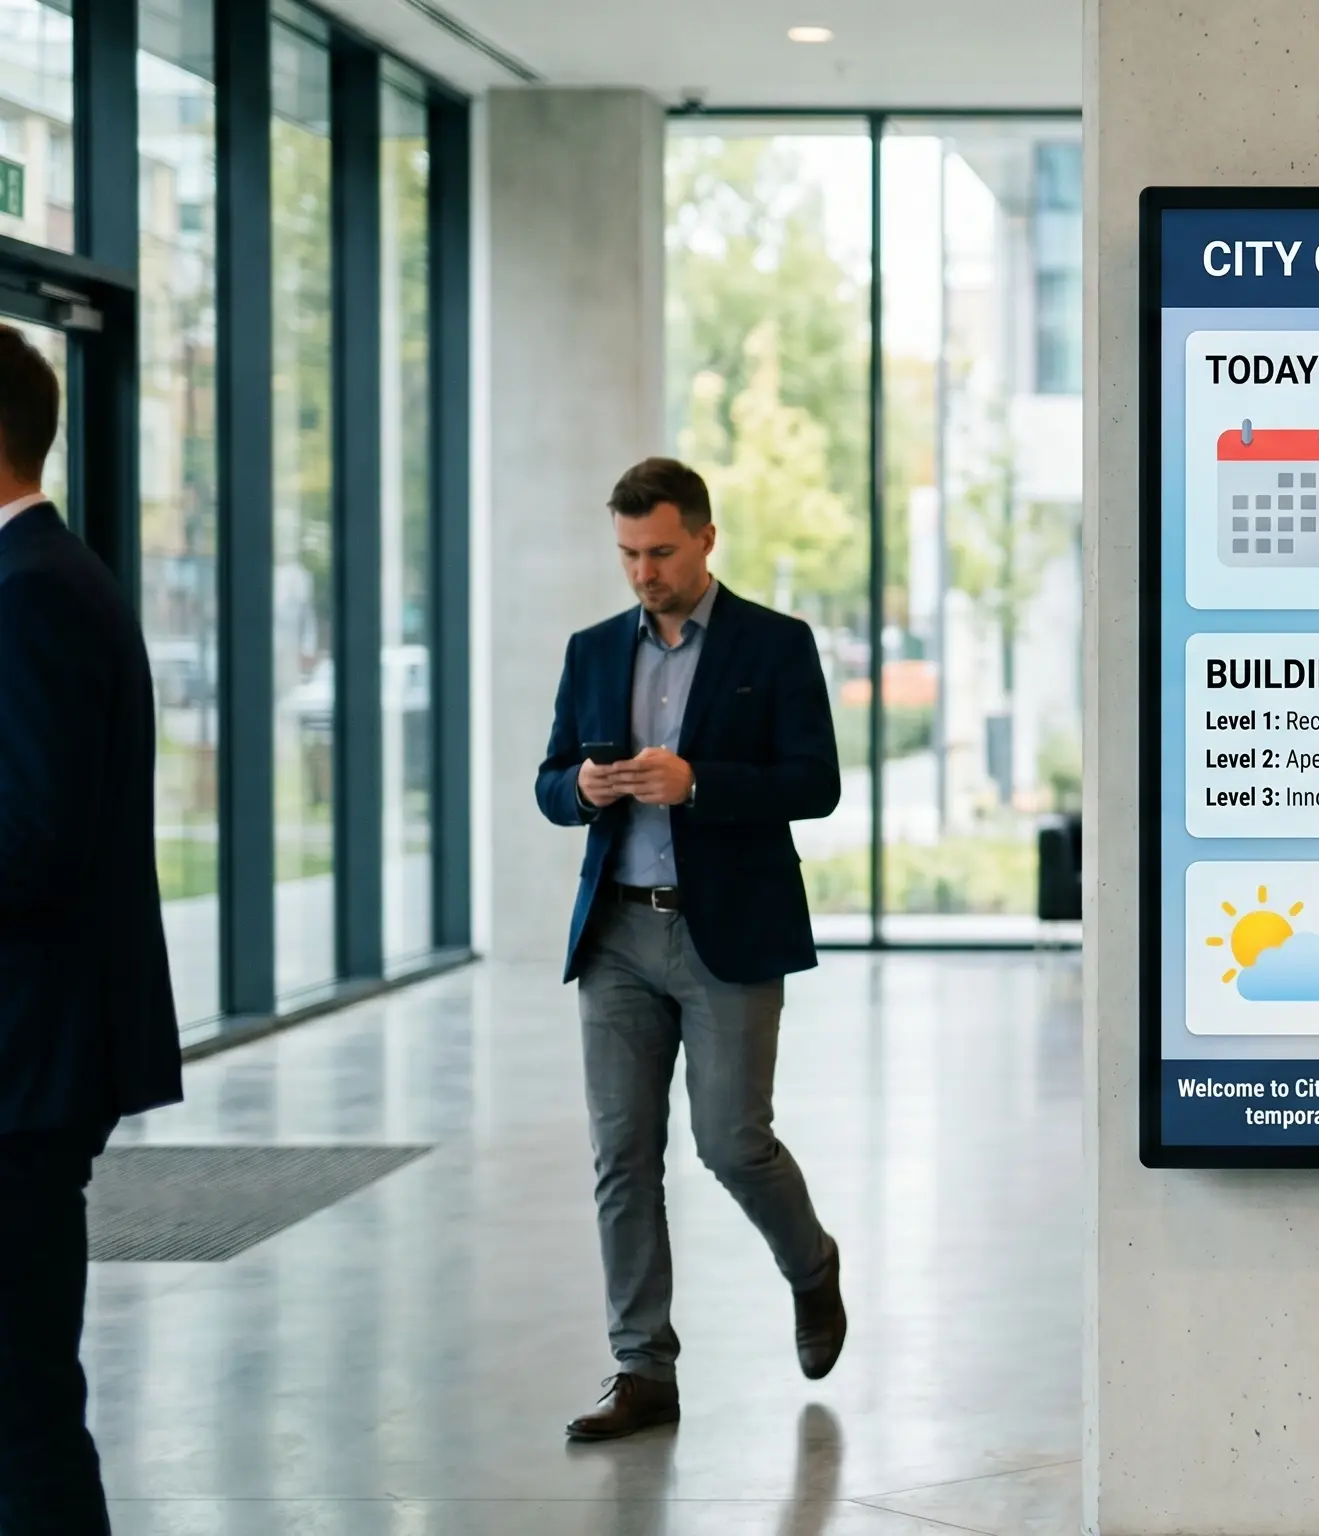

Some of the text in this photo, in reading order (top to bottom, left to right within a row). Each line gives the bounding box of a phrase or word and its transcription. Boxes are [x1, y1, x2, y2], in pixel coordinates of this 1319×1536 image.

[1204, 241, 1302, 276] CITY
[1207, 710, 1255, 730] Level
[1263, 711, 1279, 730] 1:
[1207, 748, 1255, 768] Level
[1262, 749, 1279, 768] 2:
[1207, 786, 1255, 806] Level
[1262, 787, 1279, 806] 3:
[1178, 1078, 1264, 1097] Welcome
[1270, 1080, 1289, 1097] to
